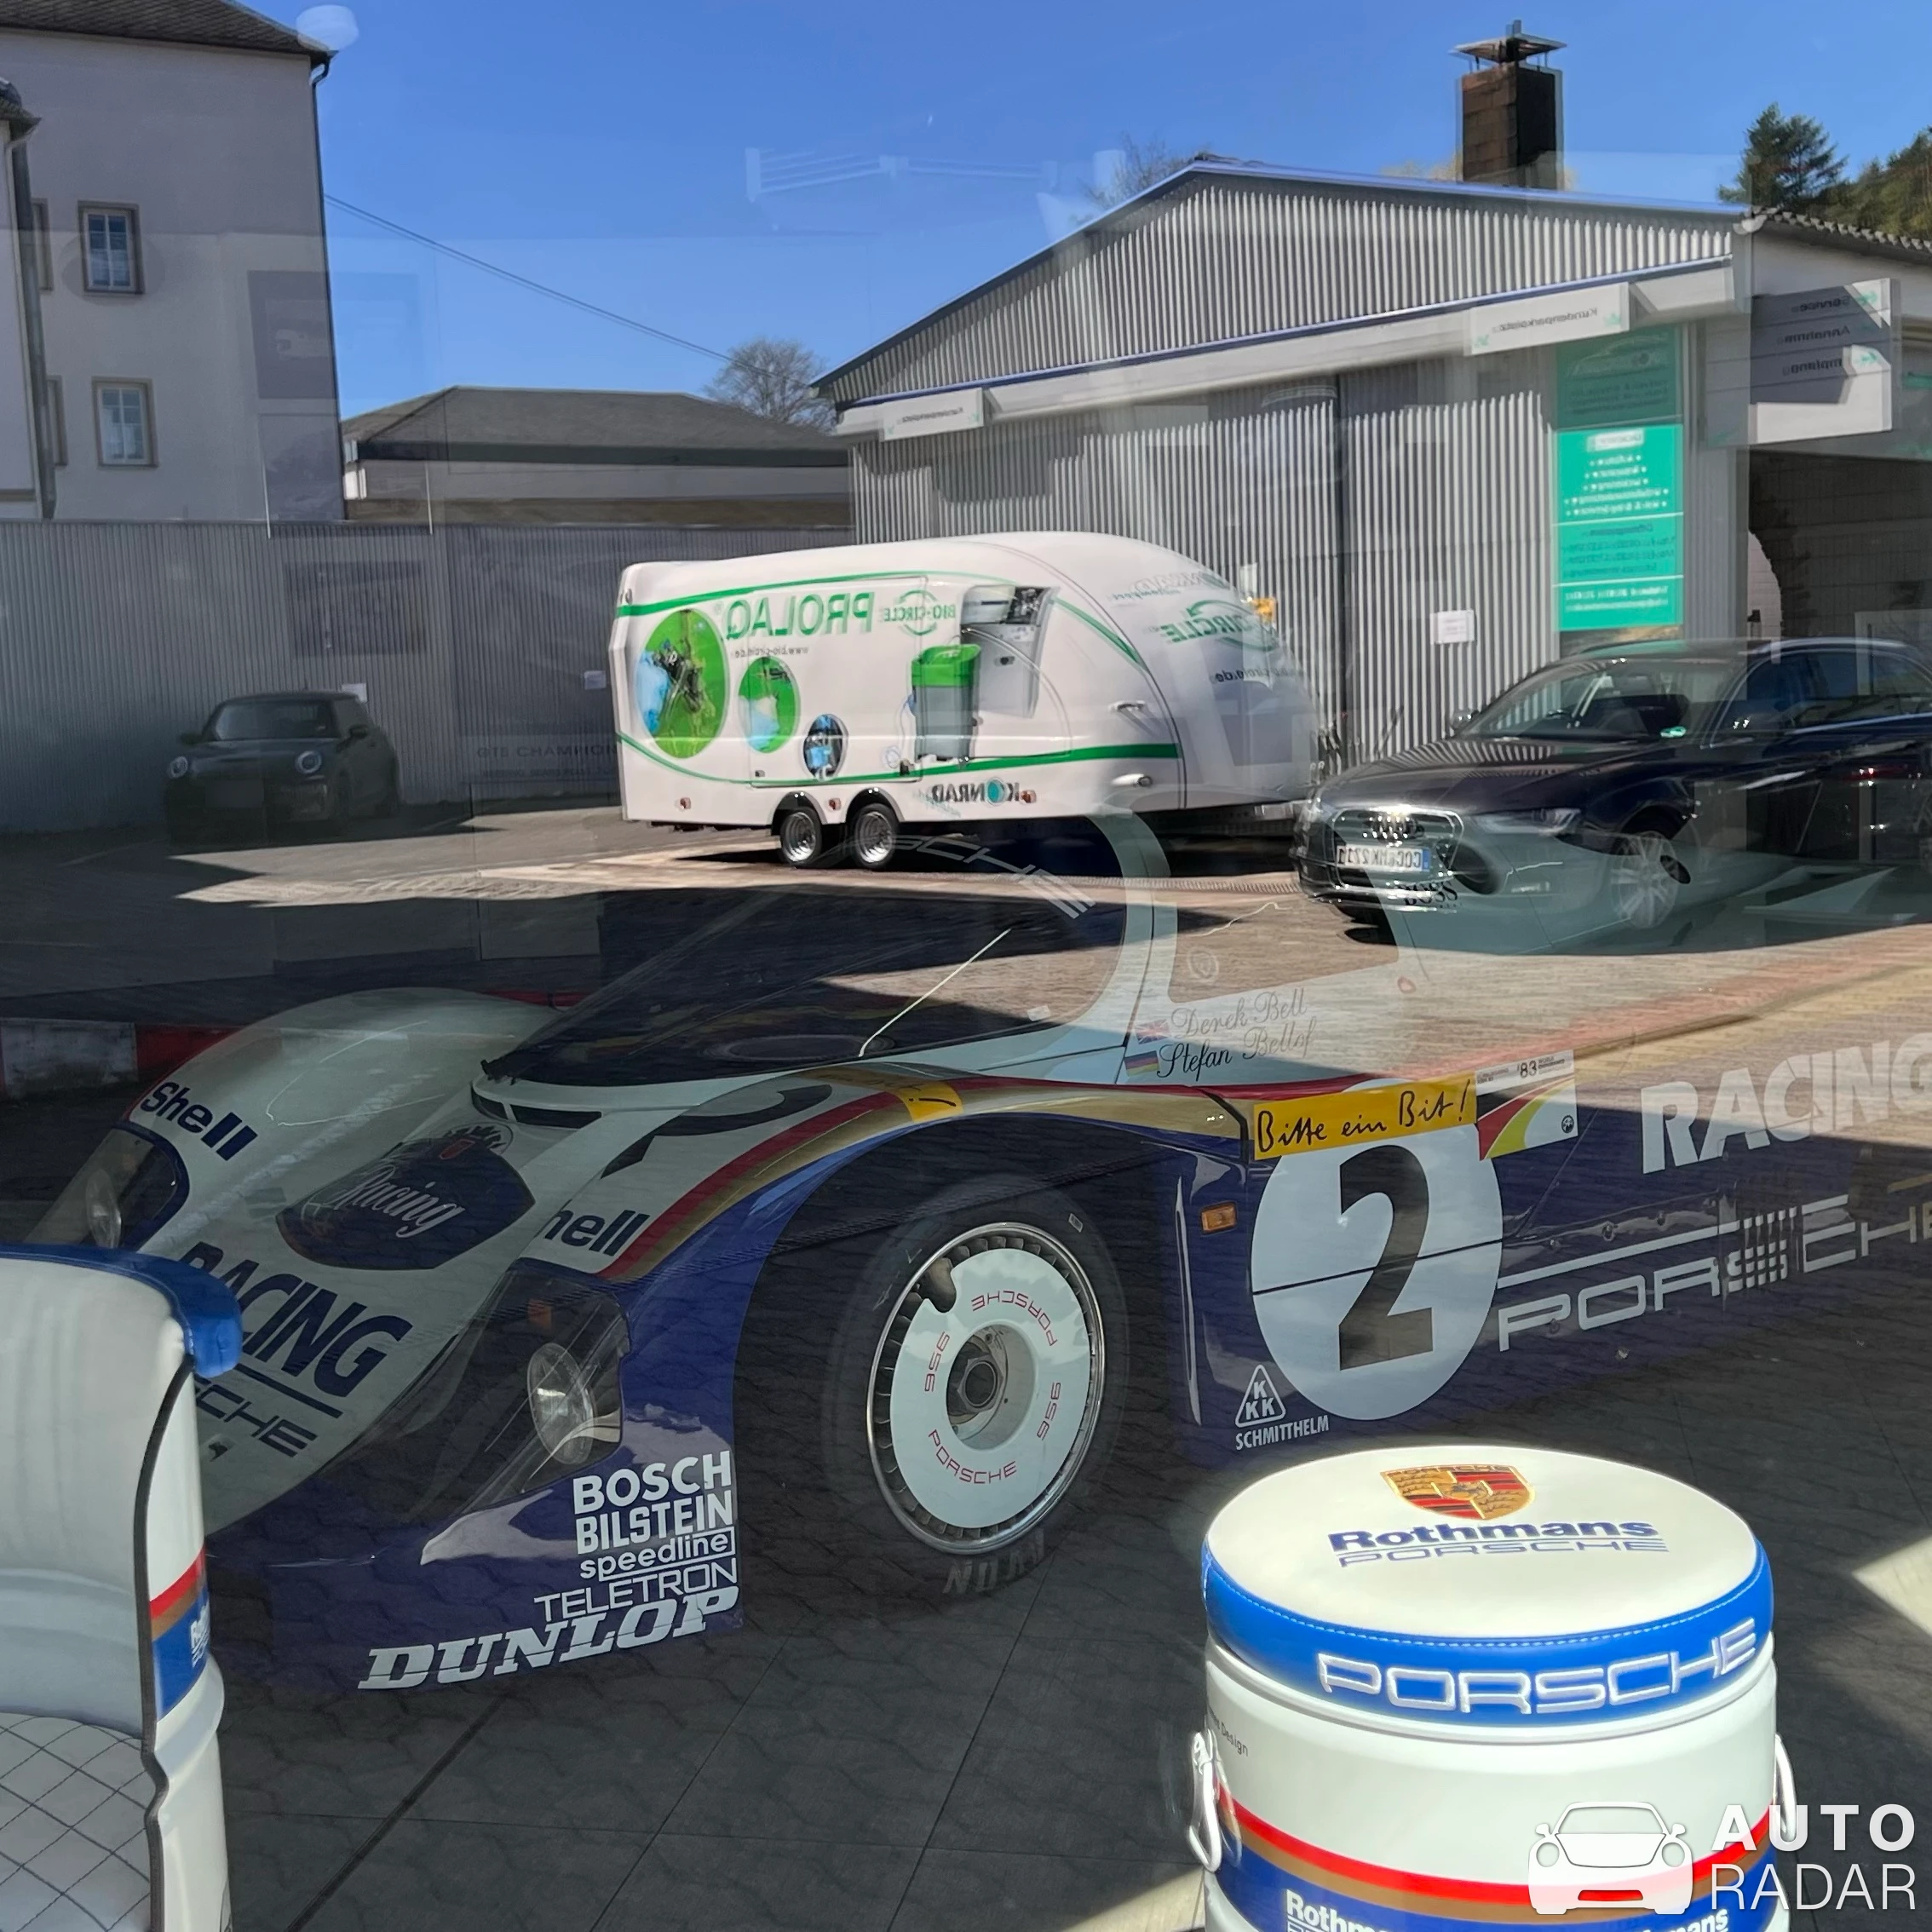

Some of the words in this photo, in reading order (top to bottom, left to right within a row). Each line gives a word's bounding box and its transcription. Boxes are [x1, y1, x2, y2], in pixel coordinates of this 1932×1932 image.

[1171, 998, 1248, 1038] Derek
[1254, 987, 1307, 1022] Bell
[1157, 1039, 1233, 1081] Stefan
[1243, 1016, 1317, 1059] Bellof
[141, 1081, 257, 1160] Shell
[1256, 1109, 1327, 1154] Bitte
[1342, 1109, 1387, 1137] ein
[1398, 1078, 1470, 1128] Bit!
[1641, 1032, 1932, 1174] RACING
[342, 1167, 465, 1238] Racing
[544, 1199, 651, 1256] hell
[1339, 1144, 1434, 1371] 2
[970, 1290, 1058, 1346] PORSCHE
[924, 1331, 951, 1392] 956
[1037, 1382, 1061, 1440] 956
[1235, 1415, 1330, 1451] SCHMITTHELM
[572, 1450, 733, 1516] BOSCH
[929, 1429, 1017, 1484] PORSCHE
[575, 1489, 733, 1555] BILSTEIN
[1328, 1520, 1657, 1552] Rothmans
[1338, 1539, 1669, 1568] PORSCHE
[579, 1527, 733, 1583] speedline
[534, 1559, 737, 1622] TELETRON
[358, 1586, 739, 1690] DUNLOP
[1317, 1617, 1757, 1716] PORSCHE
